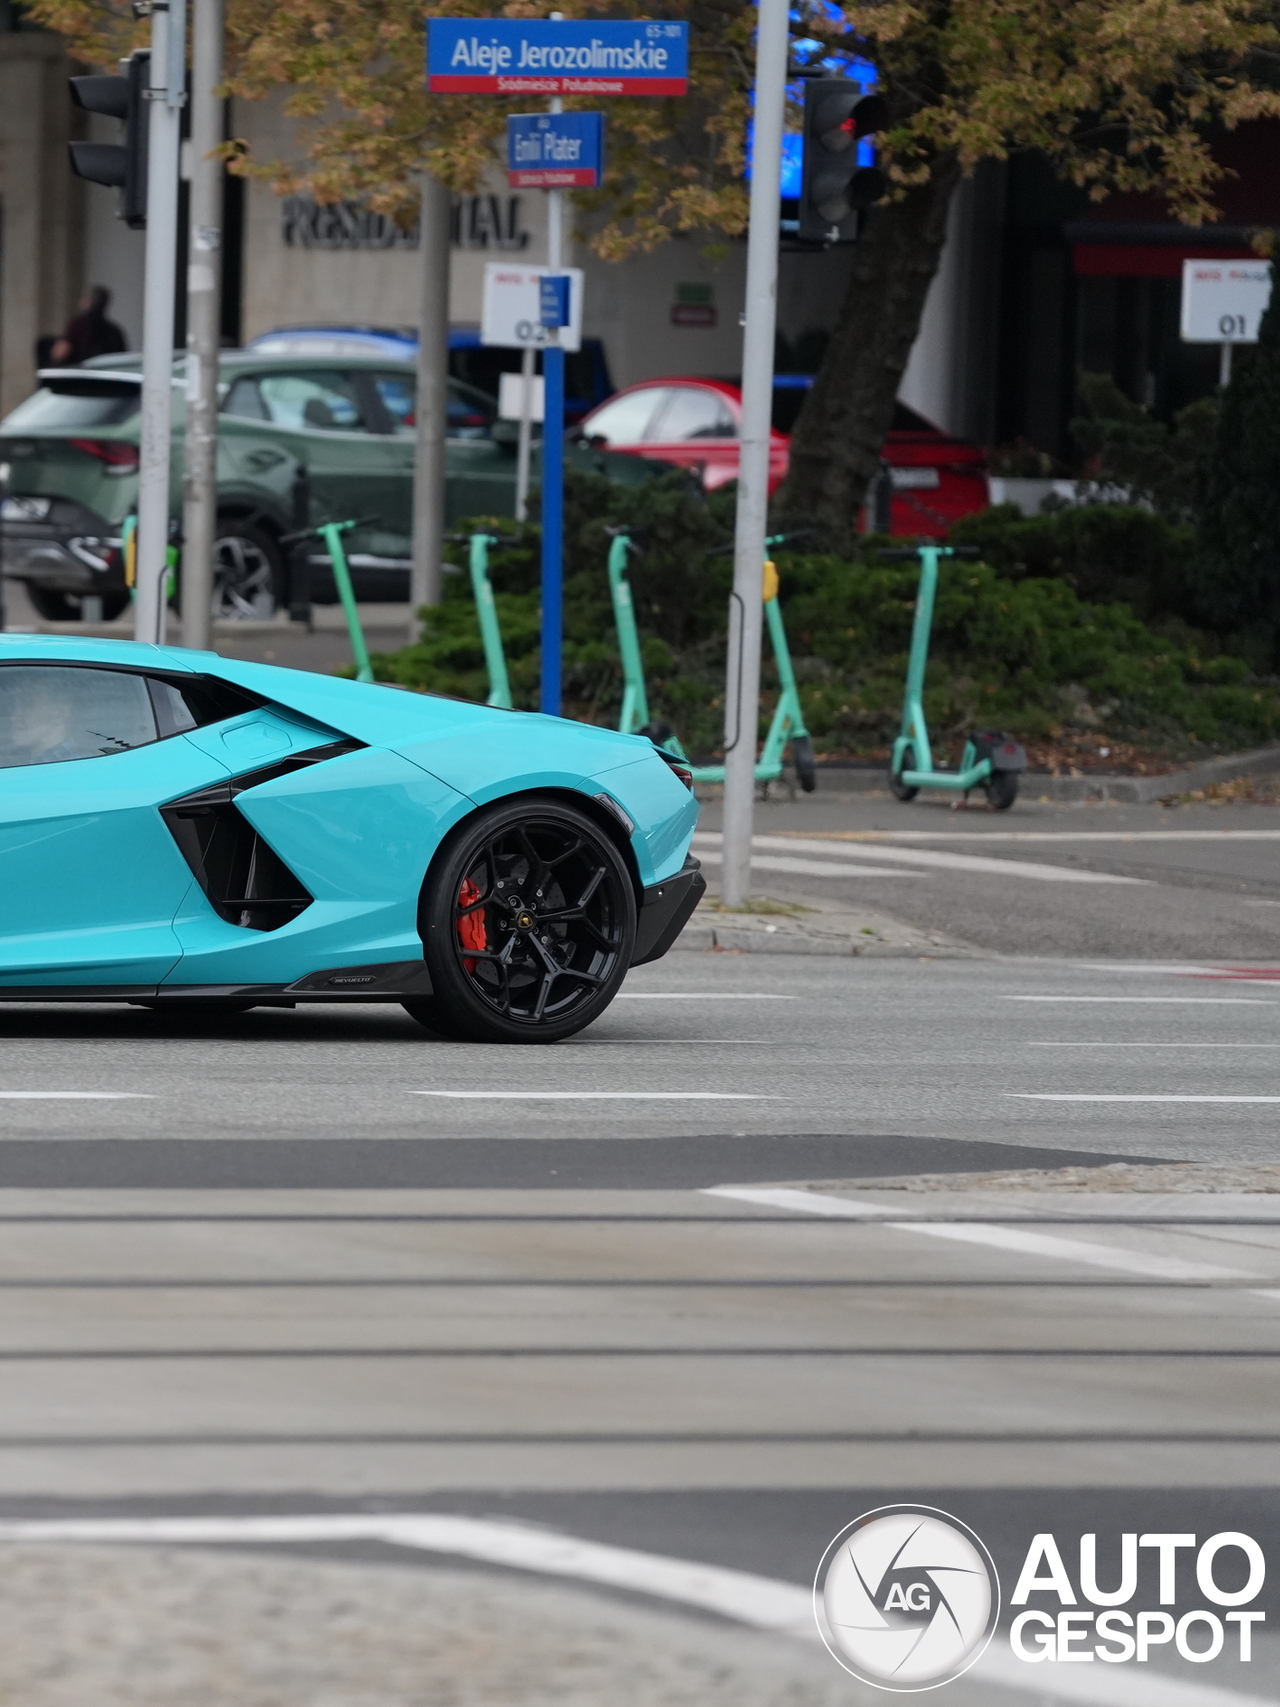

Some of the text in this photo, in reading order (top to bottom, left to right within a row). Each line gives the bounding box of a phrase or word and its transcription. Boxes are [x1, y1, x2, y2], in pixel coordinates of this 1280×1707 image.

[451, 37, 669, 75] Aleje Jerozolimskie
[497, 76, 624, 92] Śródmieście Południowe
[515, 131, 582, 162] Emilii Plater
[1219, 314, 1245, 336] 01
